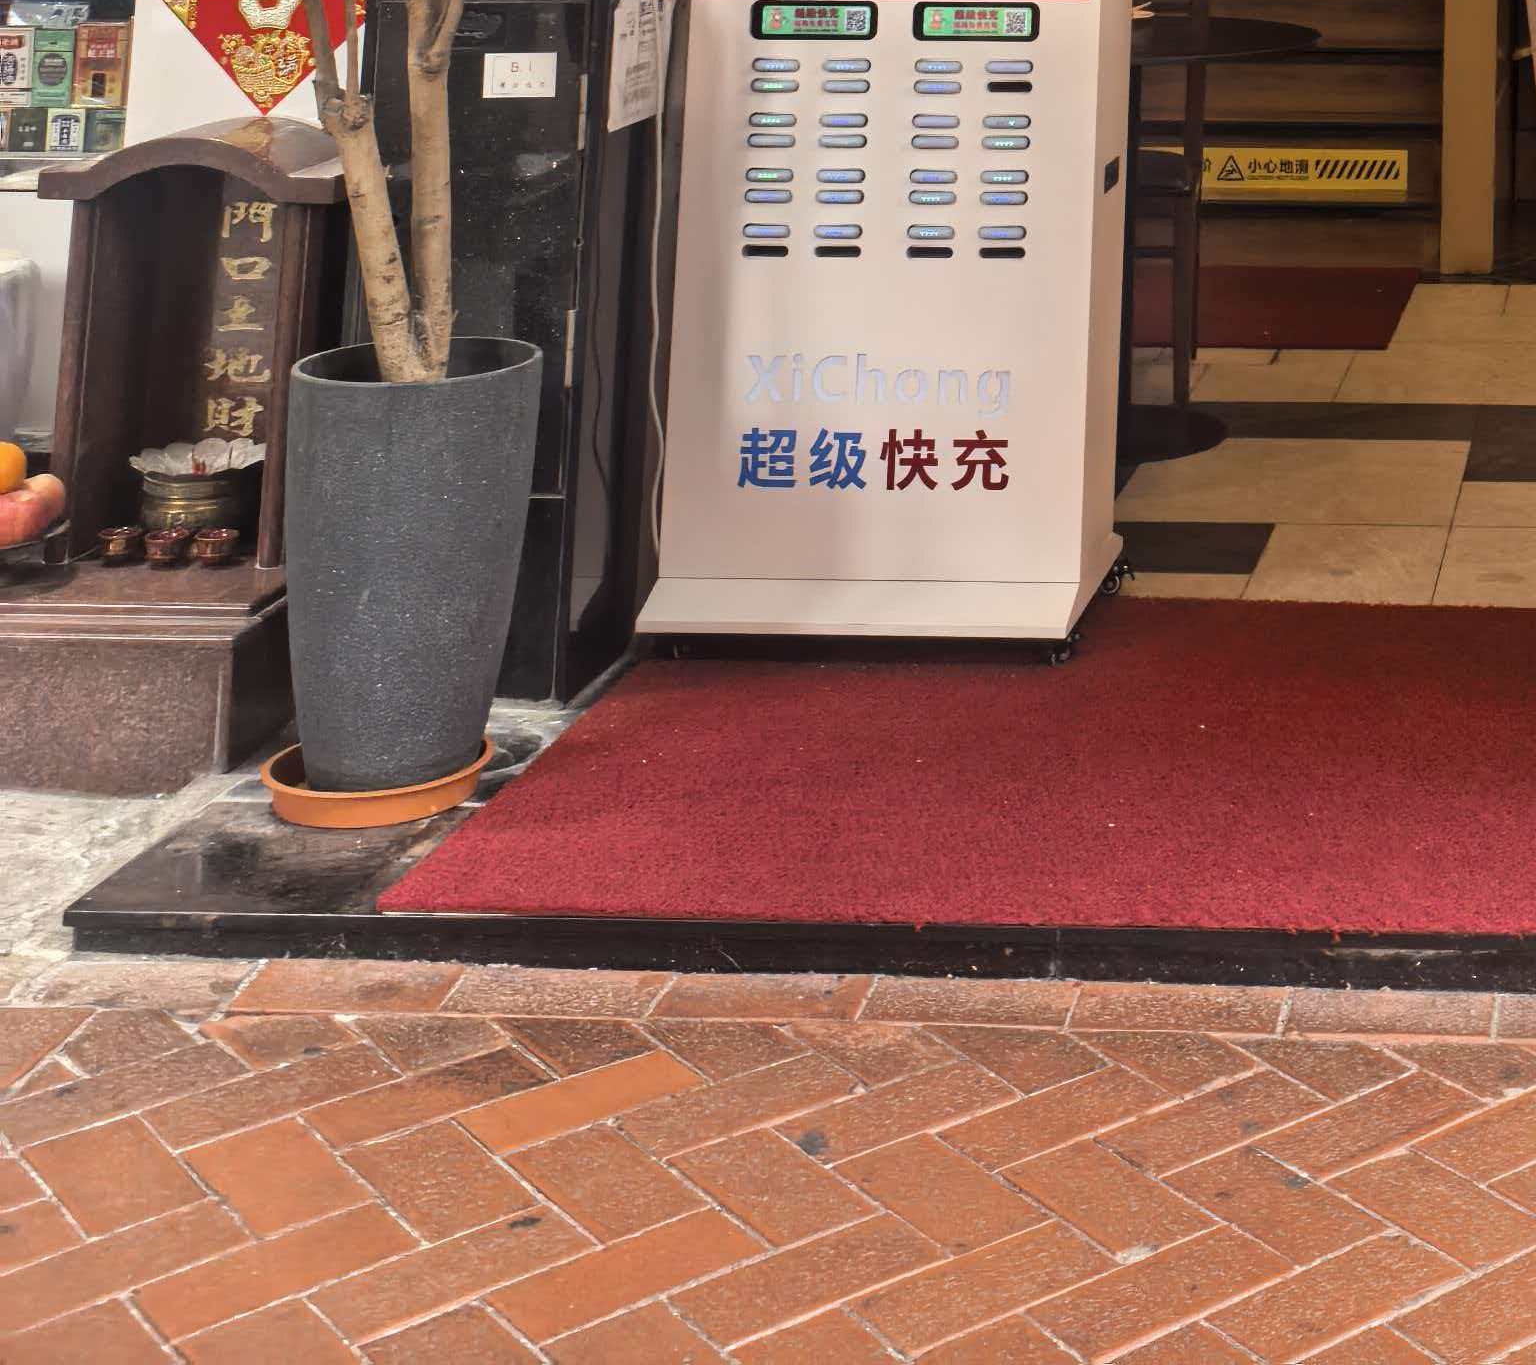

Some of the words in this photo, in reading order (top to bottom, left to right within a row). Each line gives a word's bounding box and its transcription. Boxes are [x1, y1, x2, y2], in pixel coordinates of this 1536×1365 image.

[204, 200, 278, 437] 門口土地財
[743, 353, 1012, 421] XiChong
[737, 426, 1011, 492] 超级快充
